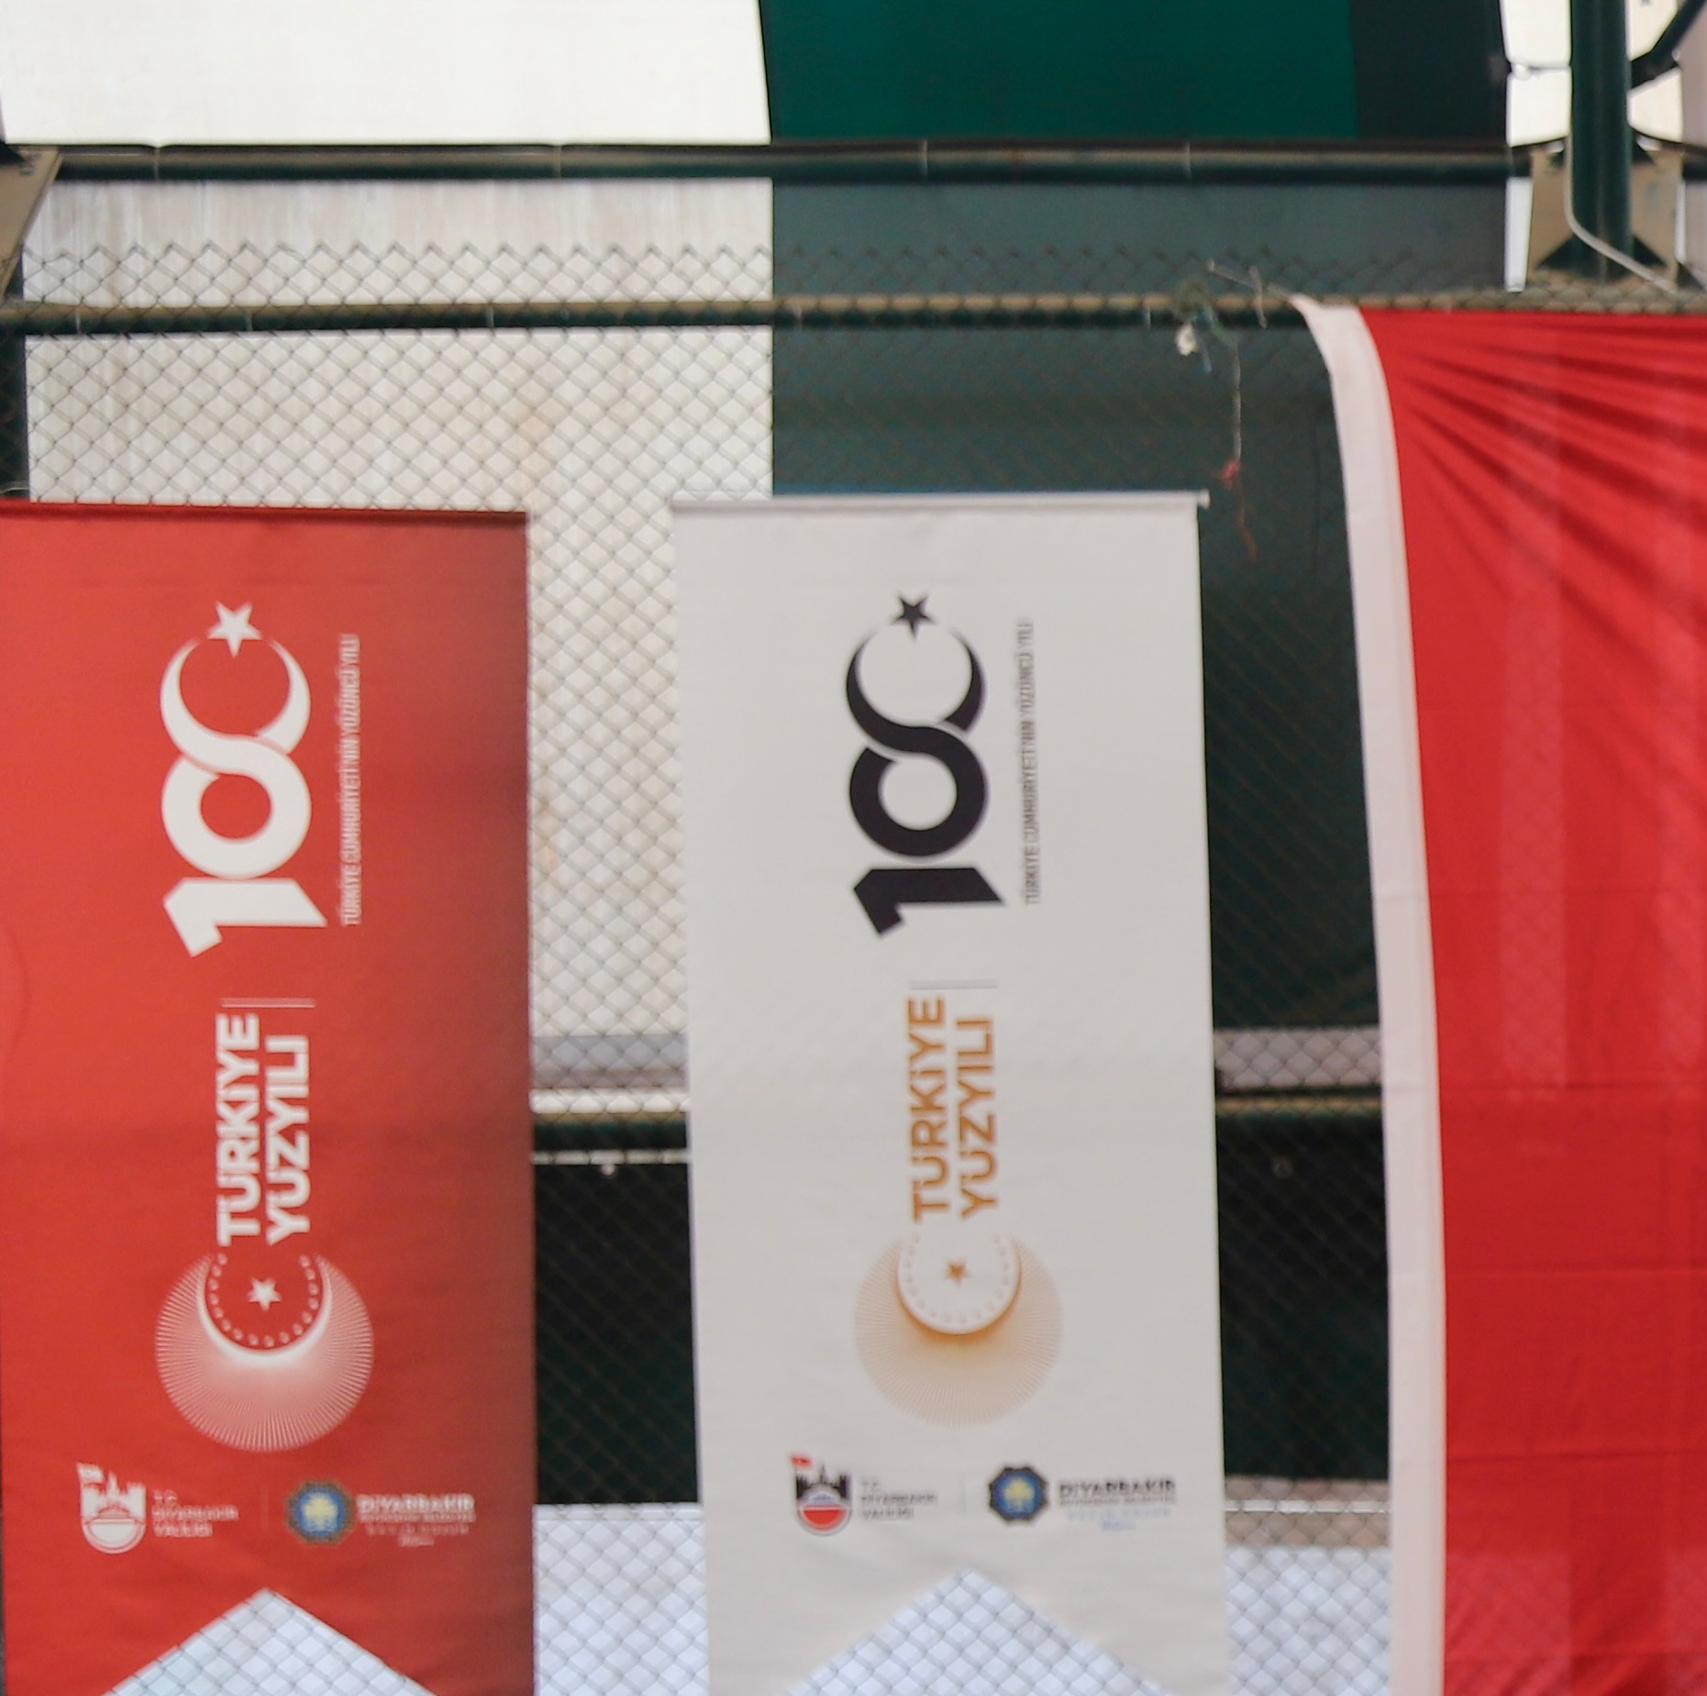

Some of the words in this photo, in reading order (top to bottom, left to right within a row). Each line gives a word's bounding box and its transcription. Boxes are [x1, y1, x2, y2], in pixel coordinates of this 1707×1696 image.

[216, 1012, 261, 1246] TÜRKİYE
[266, 1035, 310, 1245] YÜZYILI
[907, 996, 950, 1222] TÜRKİYE
[956, 1016, 999, 1221] YÜZYILI
